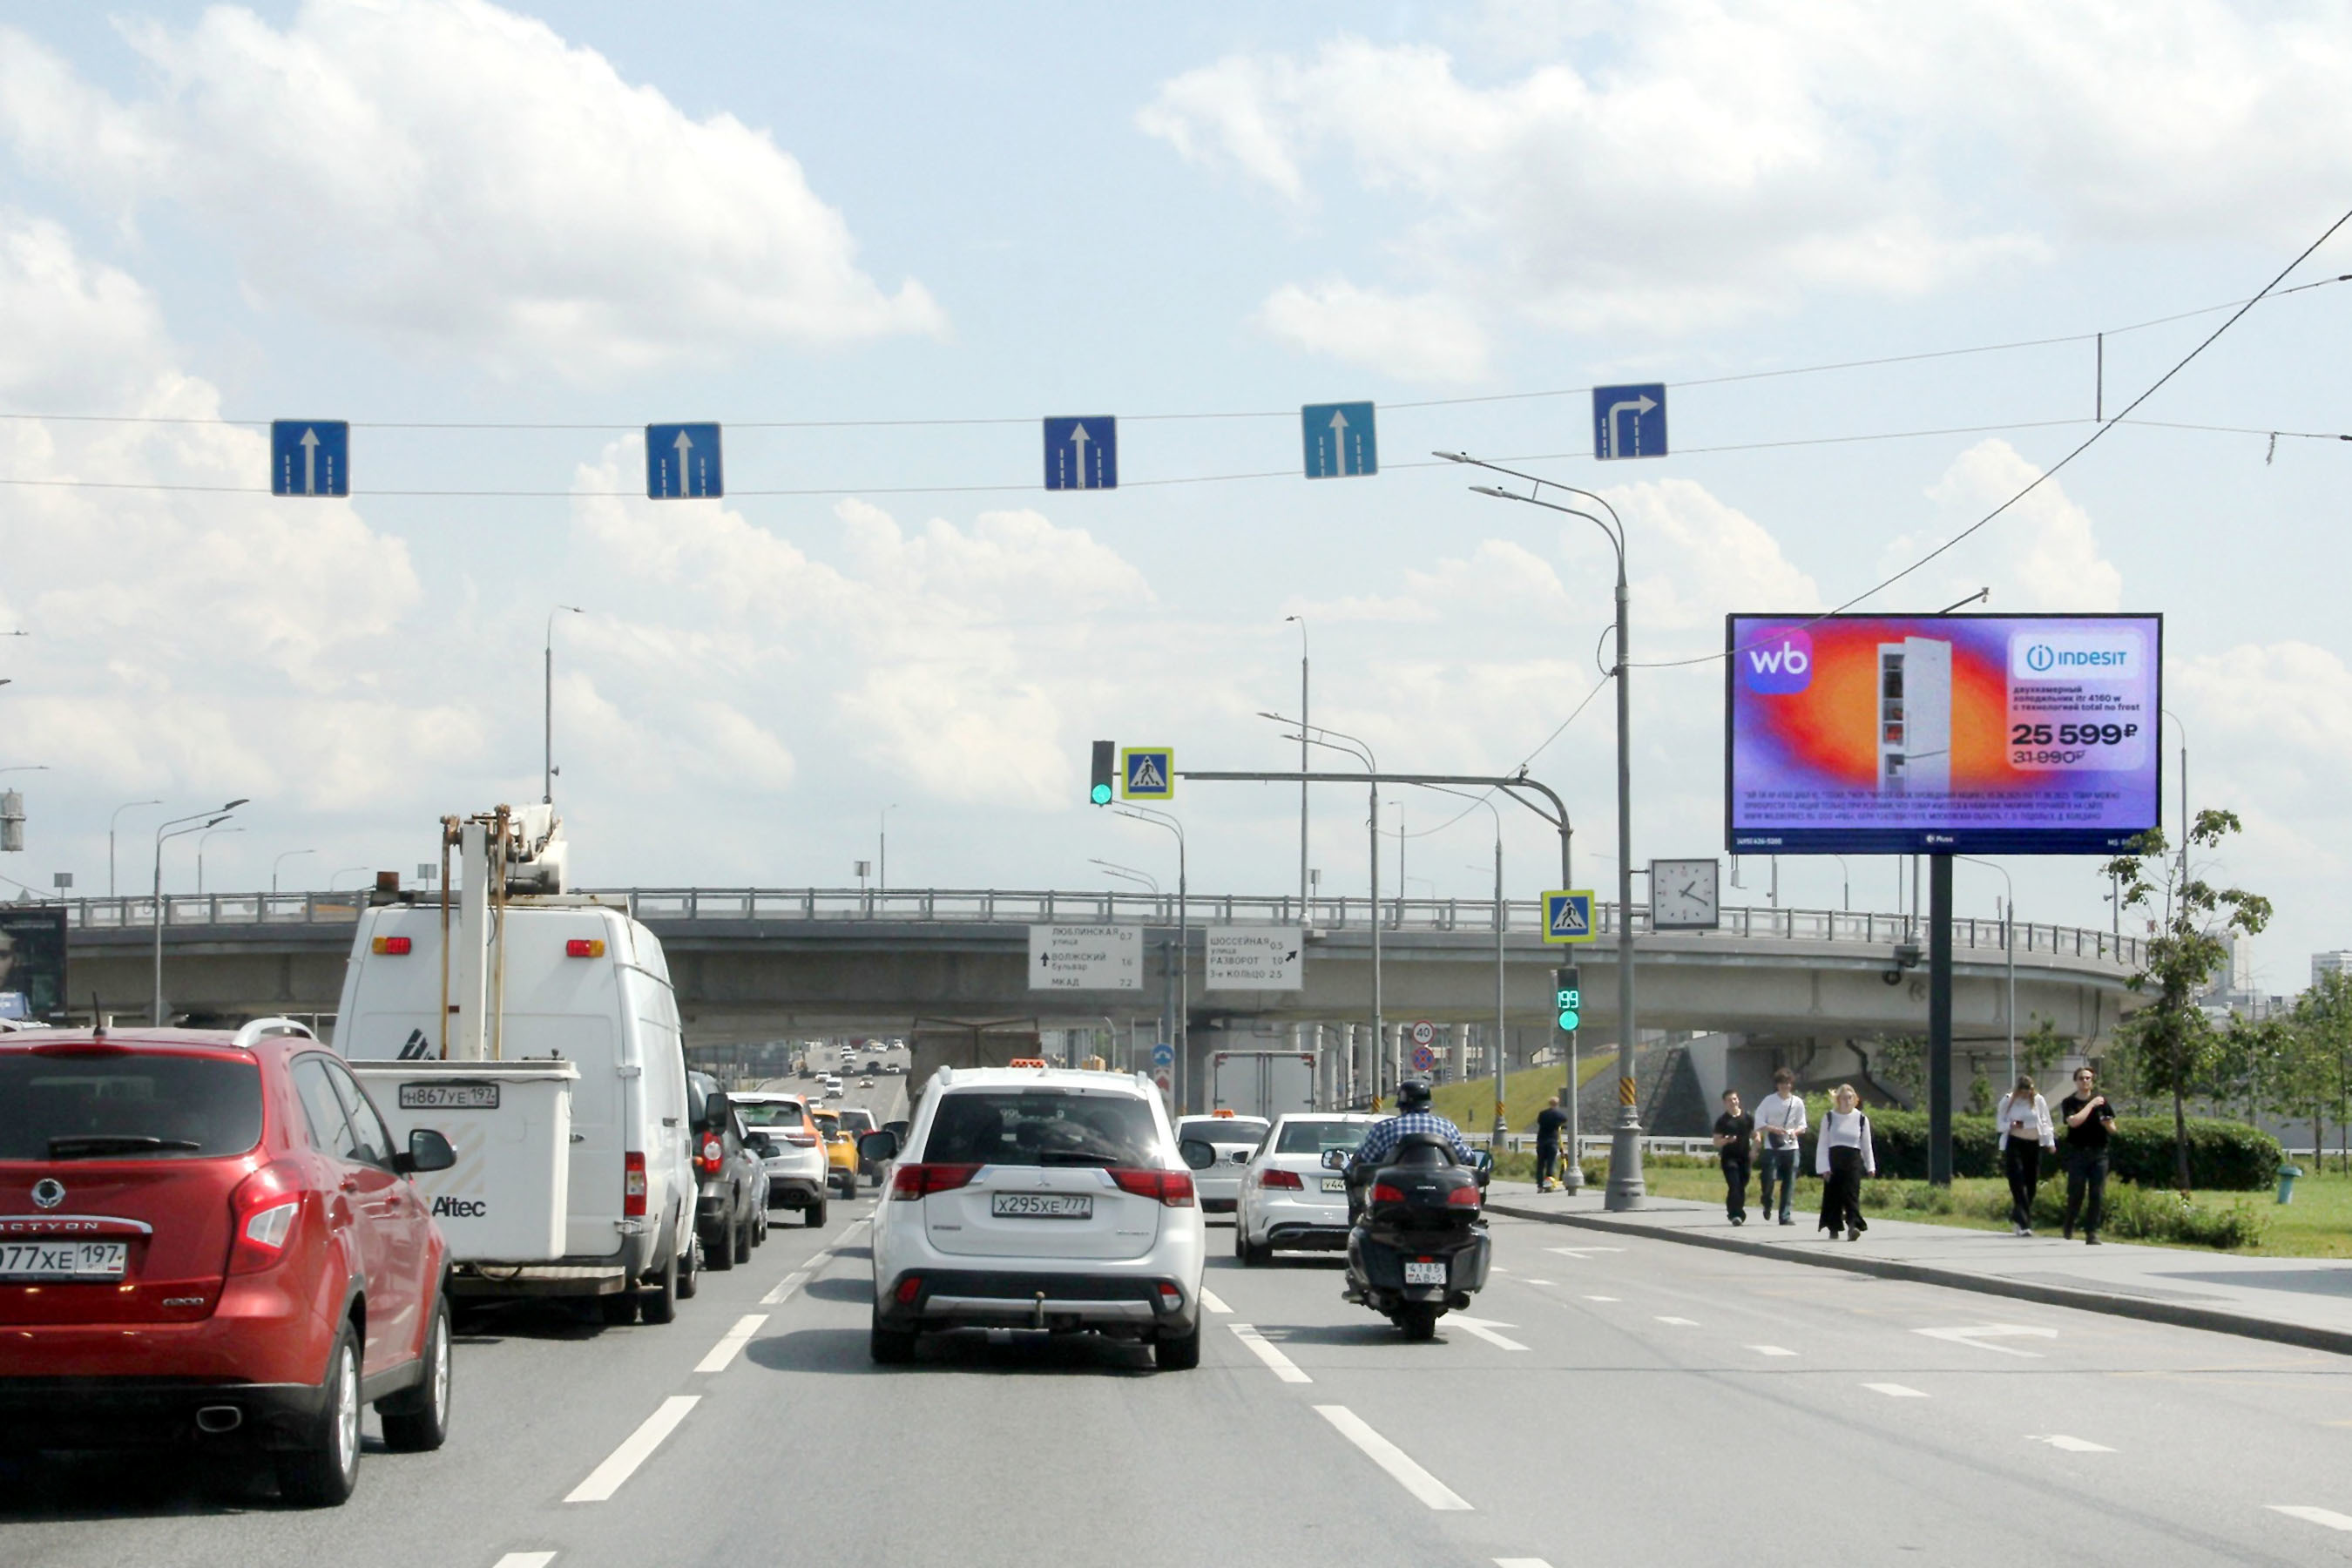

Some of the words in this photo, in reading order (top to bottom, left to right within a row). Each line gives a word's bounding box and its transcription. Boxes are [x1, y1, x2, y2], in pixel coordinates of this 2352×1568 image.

[1749, 641, 1808, 674] wb
[2011, 724, 2052, 745] 25
[1051, 952, 1106, 961] ВОЛЖСКИЙ
[1227, 970, 1266, 979] КОЛЬЦО
[1052, 978, 1079, 987] МКАД
[1416, 1028, 1429, 1037] 40
[1064, 1198, 1086, 1209] 777
[81, 1246, 118, 1262] 197
